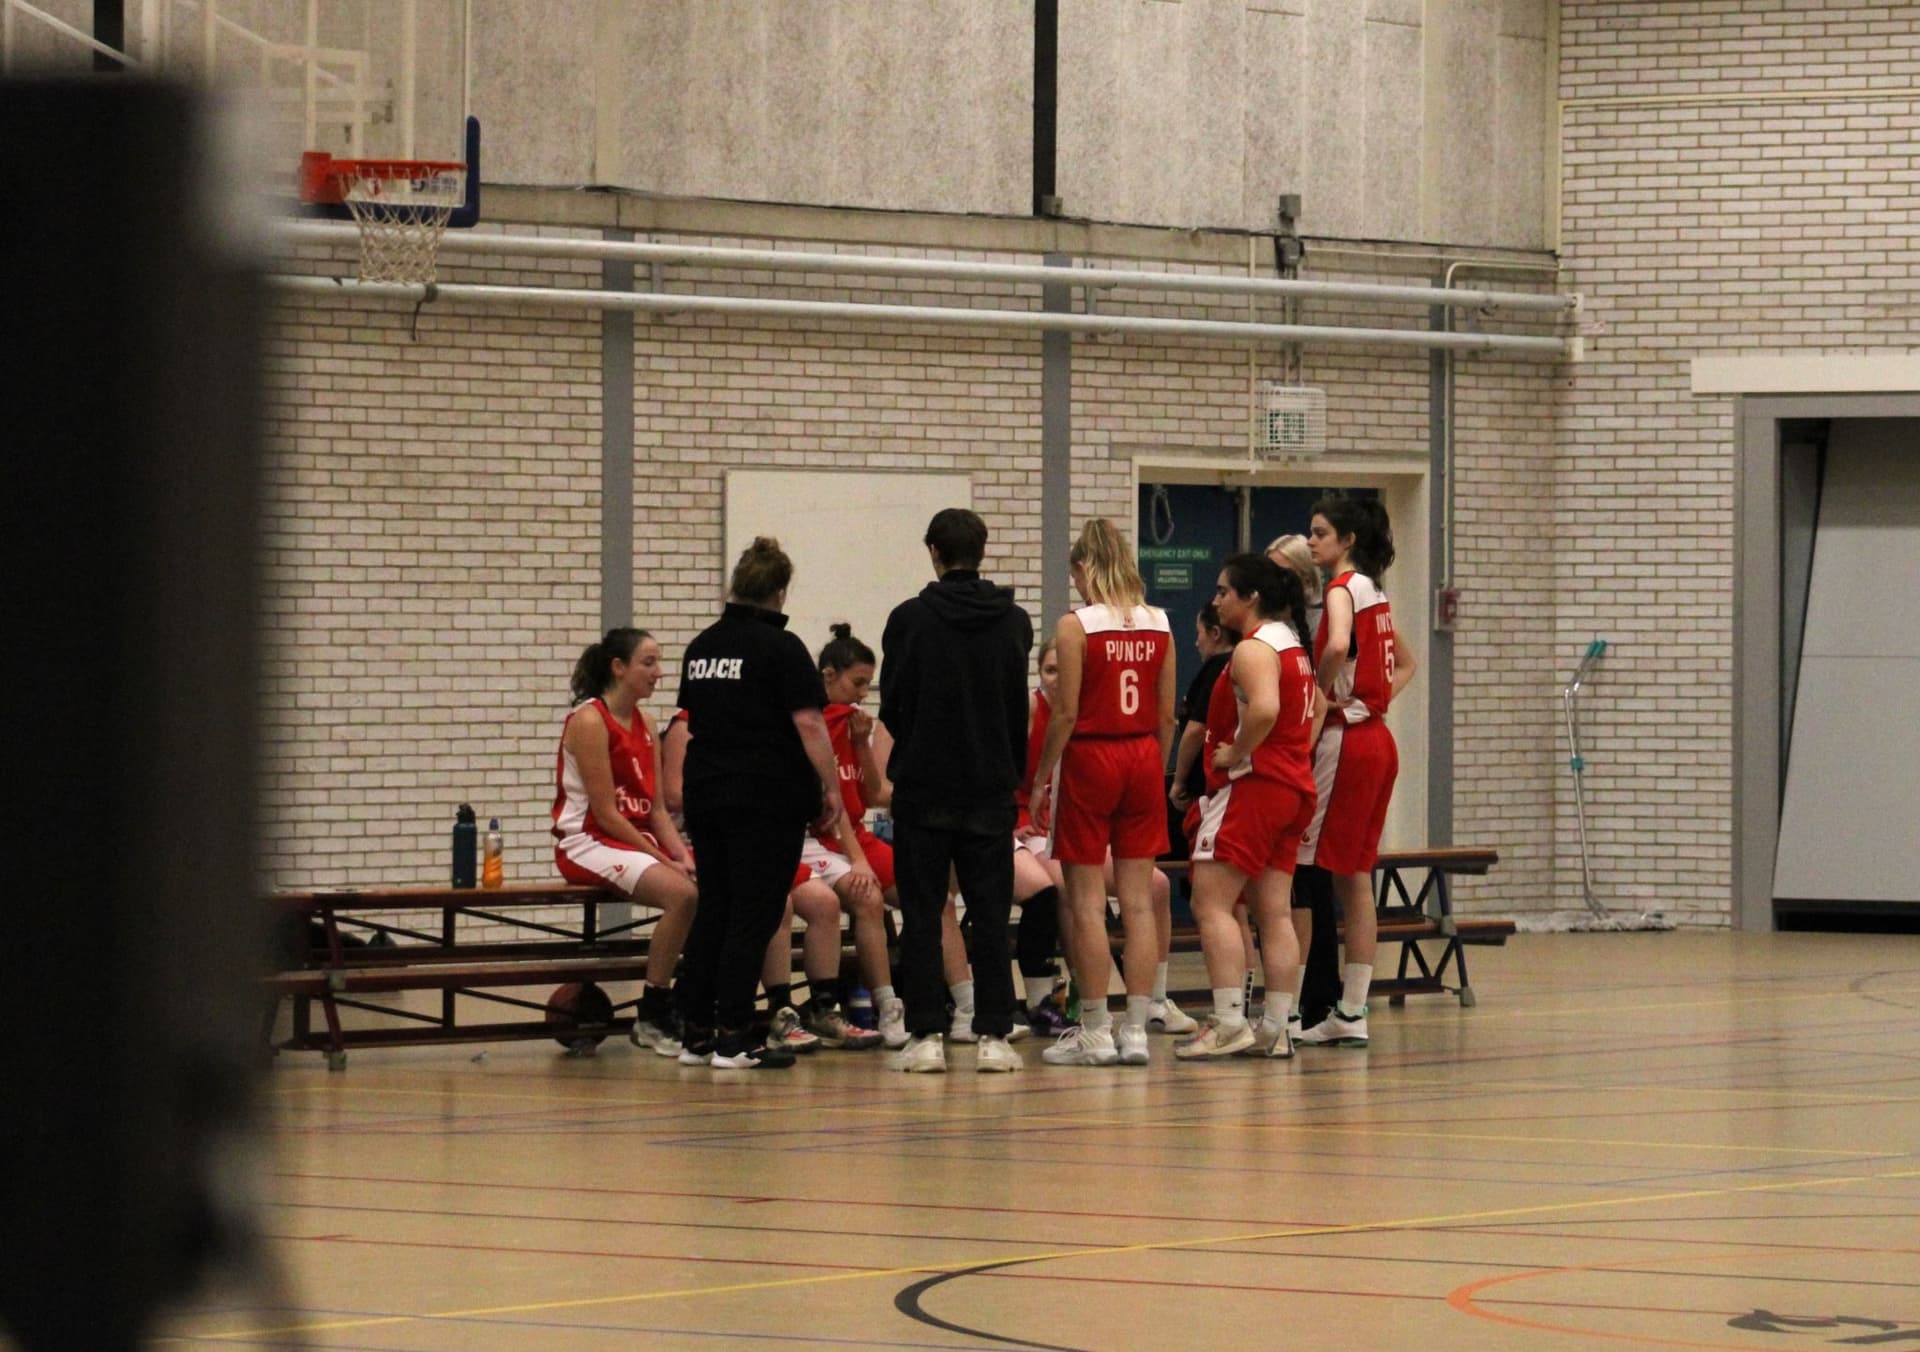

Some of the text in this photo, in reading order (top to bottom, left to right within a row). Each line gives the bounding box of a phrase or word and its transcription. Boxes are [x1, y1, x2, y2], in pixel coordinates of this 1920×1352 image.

[1105, 640, 1156, 662] PUNCH
[688, 658, 743, 680] COACH
[1120, 669, 1140, 715] 6
